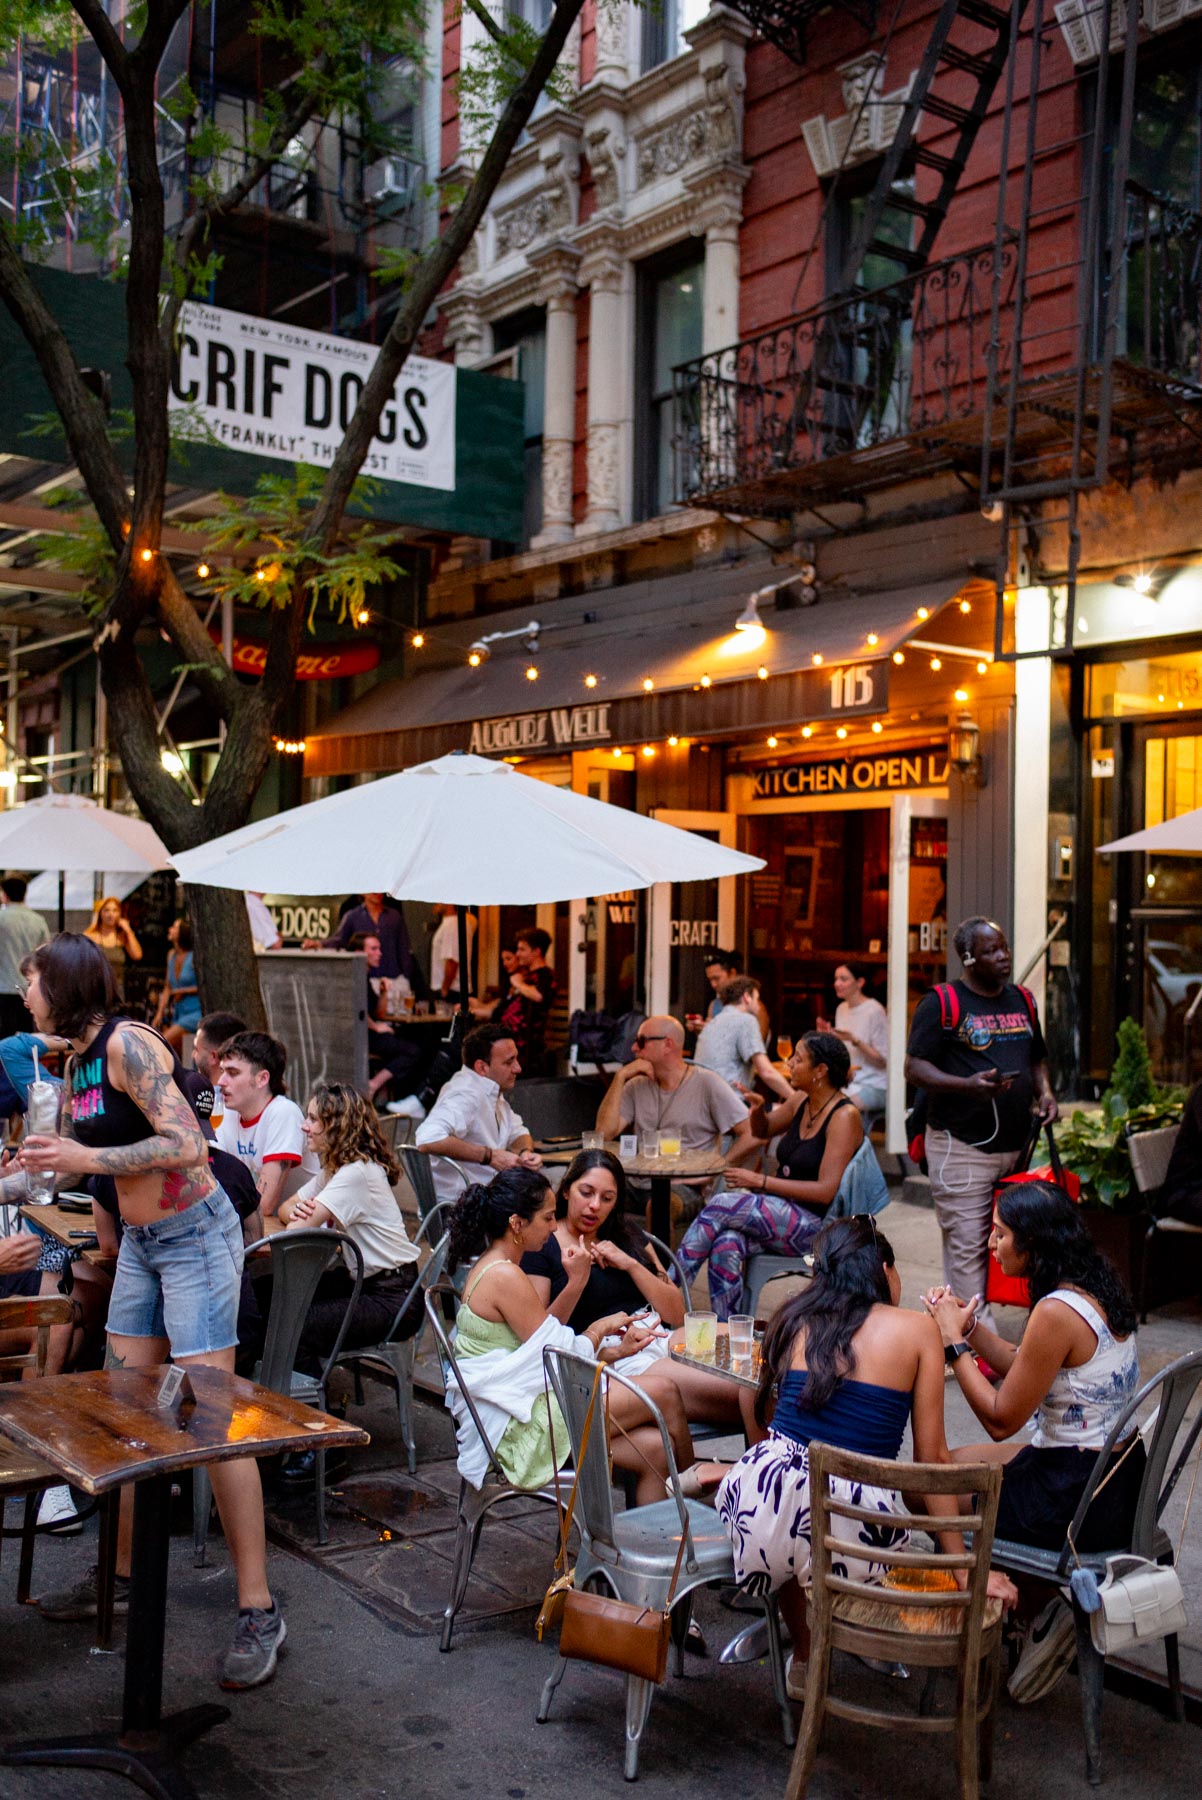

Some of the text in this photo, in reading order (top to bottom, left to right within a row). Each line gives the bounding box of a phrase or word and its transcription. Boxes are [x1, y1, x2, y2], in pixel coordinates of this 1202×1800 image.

[240, 323, 270, 337] NEW
[170, 333, 291, 420] CRIF
[830, 665, 874, 709] 115
[469, 702, 612, 755] AUGURS WELL
[753, 764, 847, 795] KITCHEN
[852, 755, 922, 790] OPEN
[282, 906, 331, 940] DOGS
[670, 920, 718, 947] CRAFT
